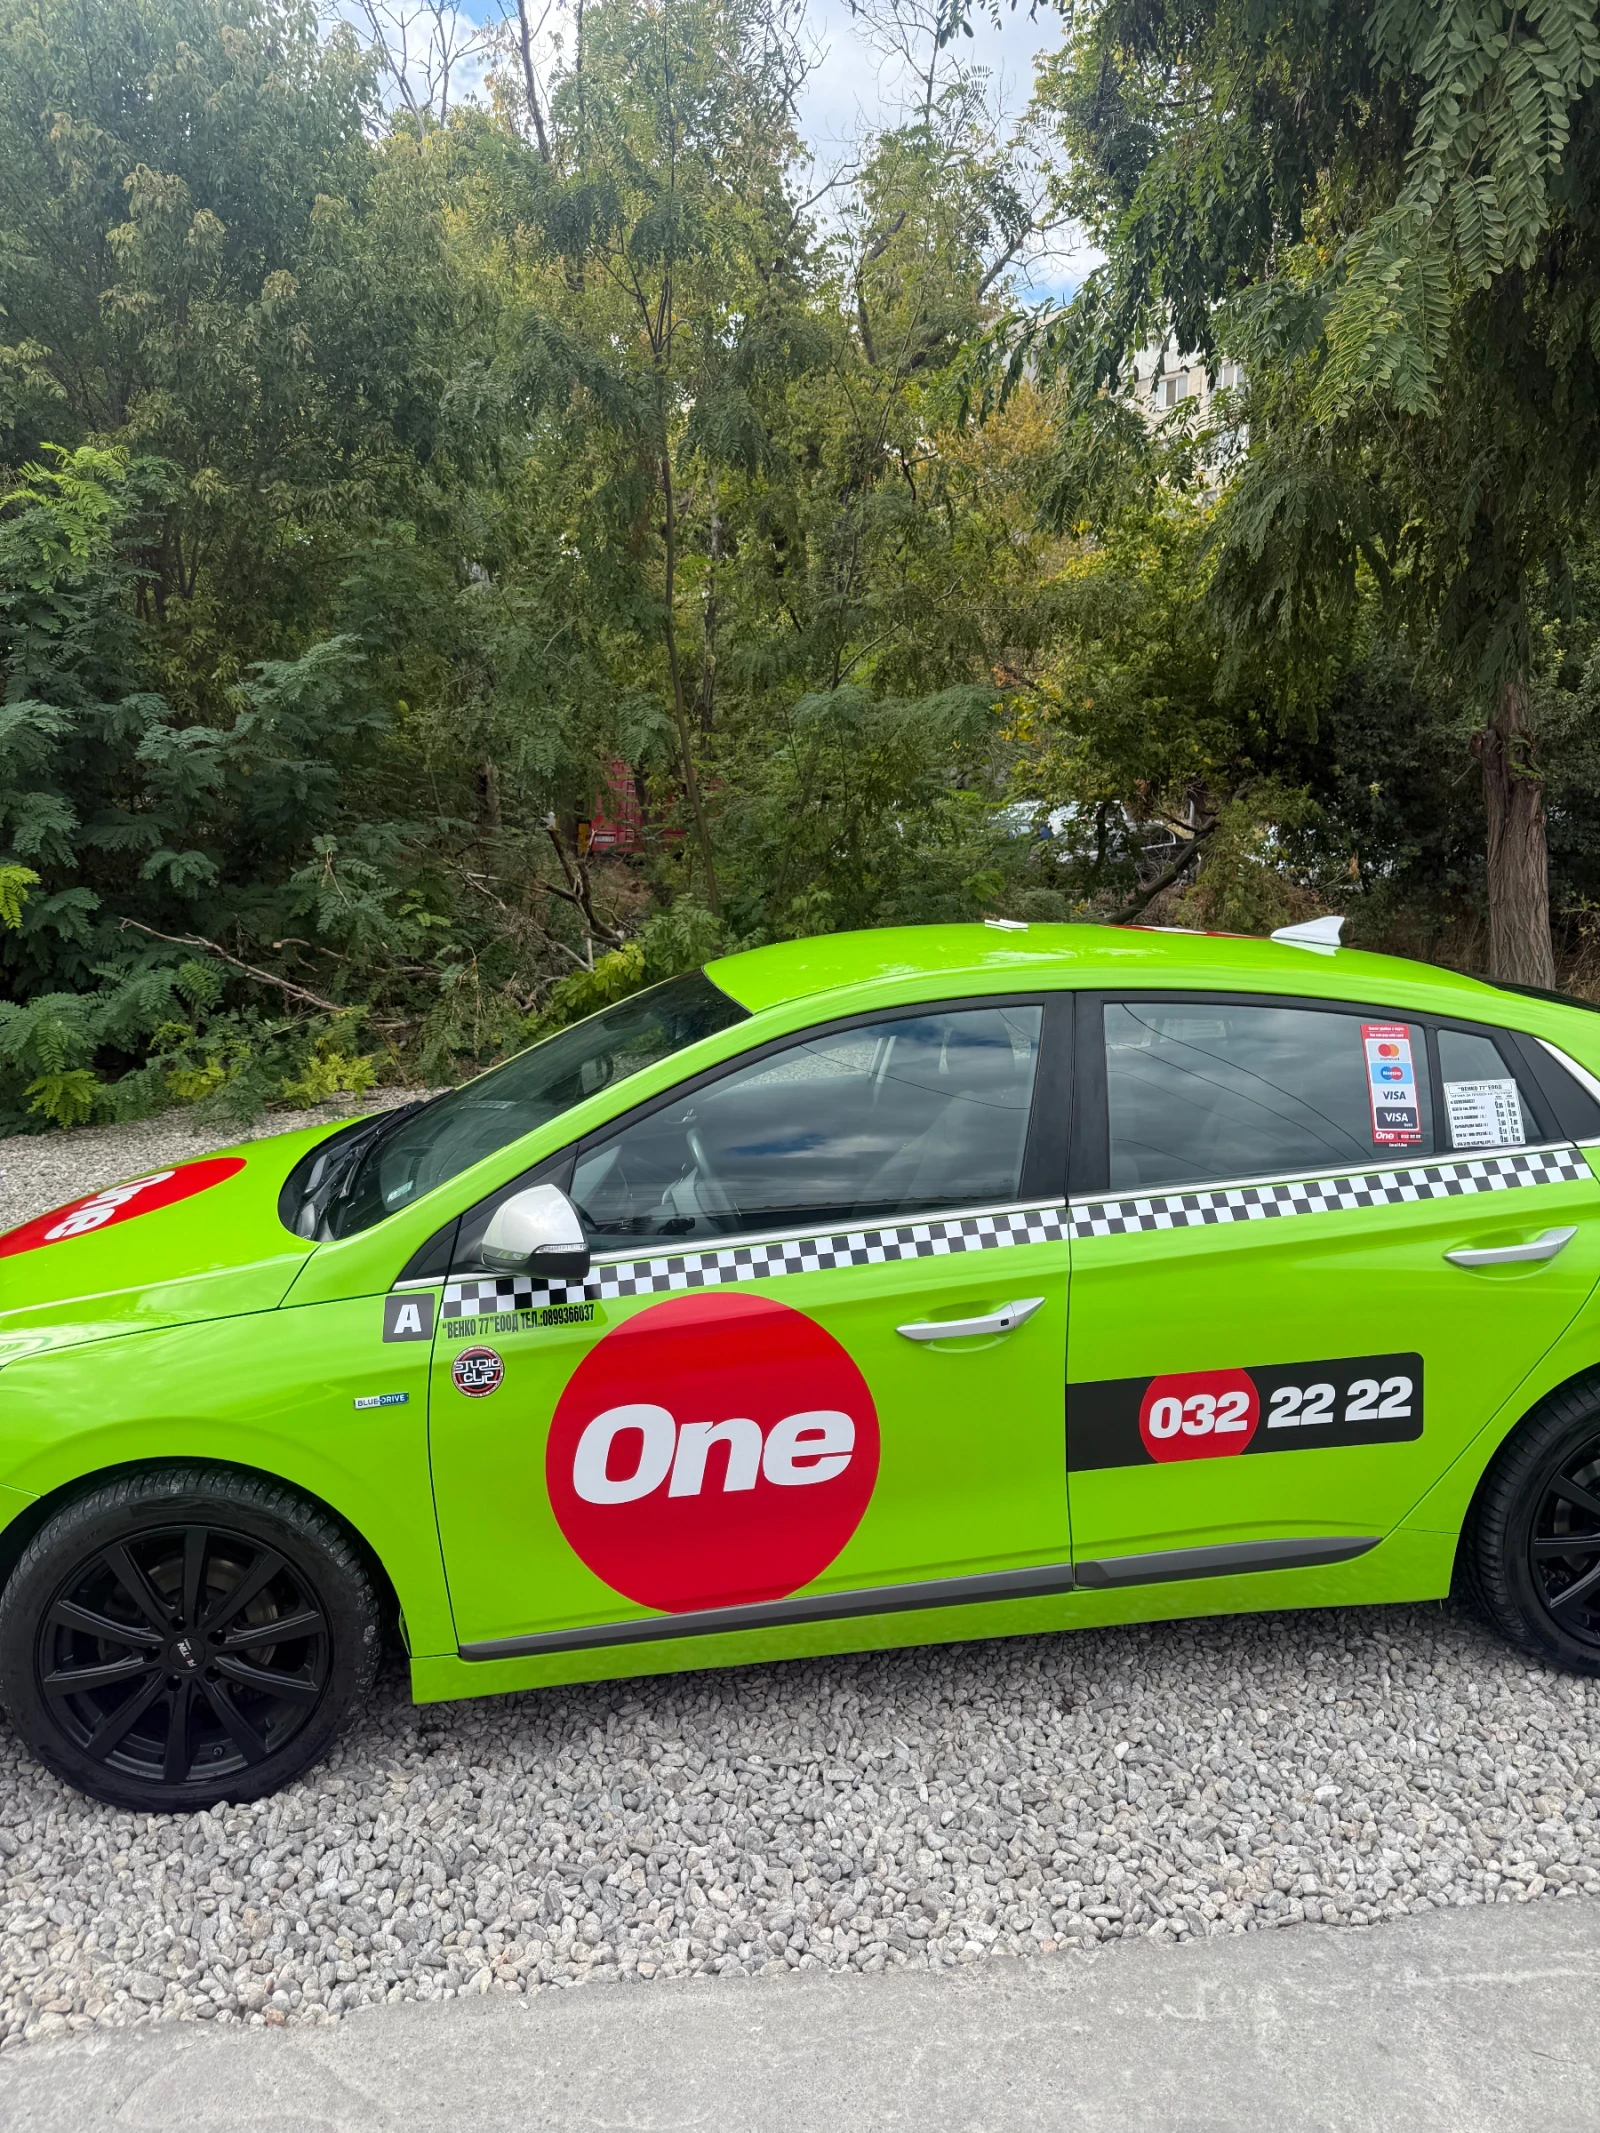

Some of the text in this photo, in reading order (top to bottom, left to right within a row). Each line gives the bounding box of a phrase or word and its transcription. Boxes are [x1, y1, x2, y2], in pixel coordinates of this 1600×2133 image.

[1381, 1091, 1406, 1100] VISA
[1383, 1112, 1409, 1122] VISA
[1375, 1131, 1394, 1140] One
[394, 1304, 421, 1333] A
[455, 1358, 501, 1374] STUDIO
[1148, 1376, 1413, 1438] 032 22 22
[572, 1404, 856, 1504] One
